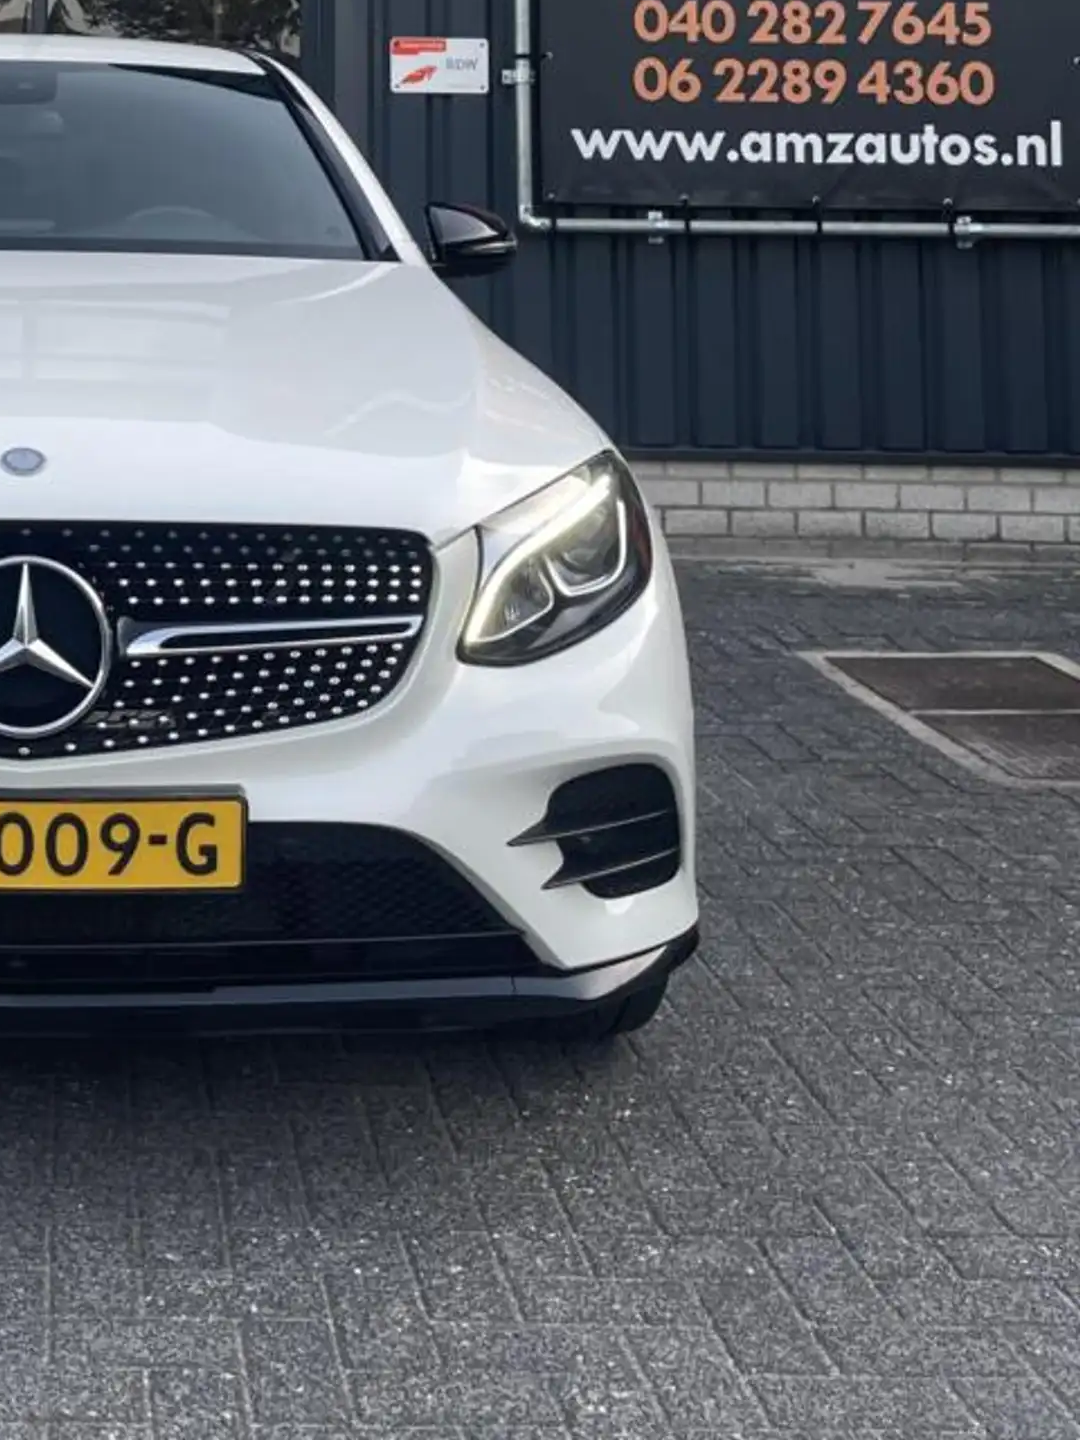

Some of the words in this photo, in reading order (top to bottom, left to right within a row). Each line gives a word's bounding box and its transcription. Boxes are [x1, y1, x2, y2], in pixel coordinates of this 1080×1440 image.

[748, 0, 846, 44] 282
[858, 0, 991, 46] 7645
[634, 58, 701, 101] 06
[714, 59, 846, 103] 2289
[858, 61, 995, 105] 4360
[571, 120, 1062, 166] www.amzautos.nl
